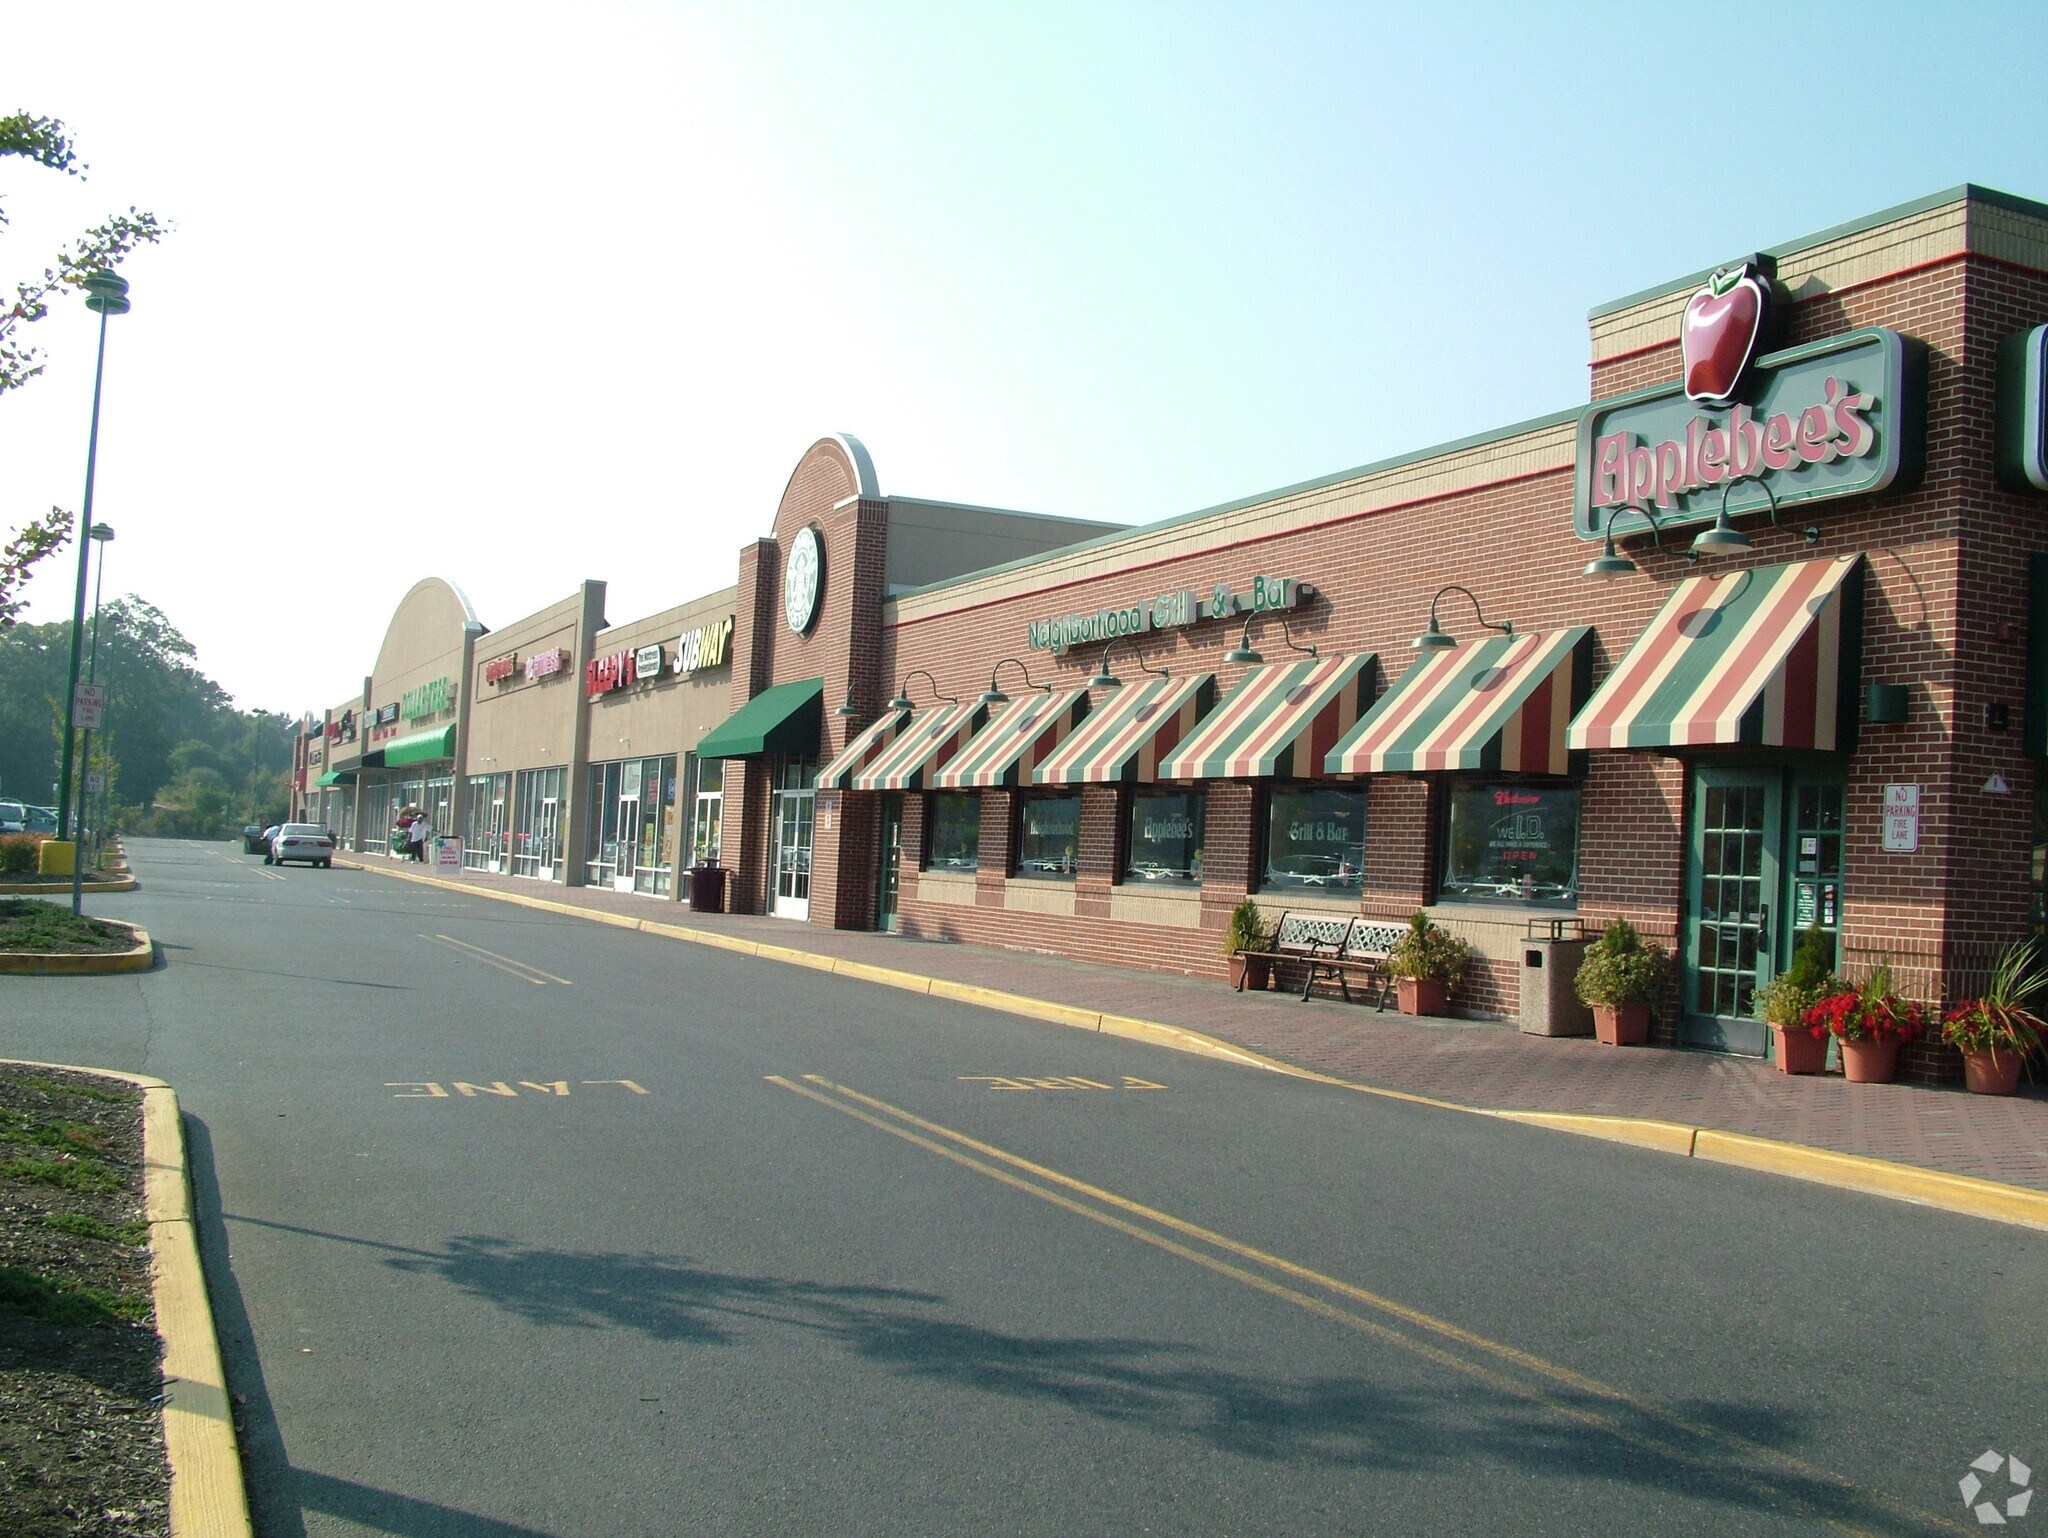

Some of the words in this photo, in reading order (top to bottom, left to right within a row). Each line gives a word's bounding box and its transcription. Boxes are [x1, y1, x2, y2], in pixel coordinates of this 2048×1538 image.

[1591, 375, 1874, 513] Applebee's
[1028, 600, 1150, 656] Neighborhood
[1152, 591, 1196, 628] Grill
[1212, 583, 1236, 619] &
[1254, 575, 1299, 612] Bar
[673, 614, 734, 674] SUBWAY
[84, 687, 96, 697] NO
[76, 698, 102, 708] PARKING
[1895, 789, 1908, 802] NO
[1885, 804, 1916, 818] PARKING
[1144, 817, 1193, 843] Applebee's
[1289, 822, 1314, 841] Grill
[1316, 822, 1325, 841] &
[1327, 822, 1348, 841] Bar
[1893, 819, 1908, 829] FIRE
[1891, 830, 1908, 840] LANE
[384, 1080, 650, 1098] LANE
